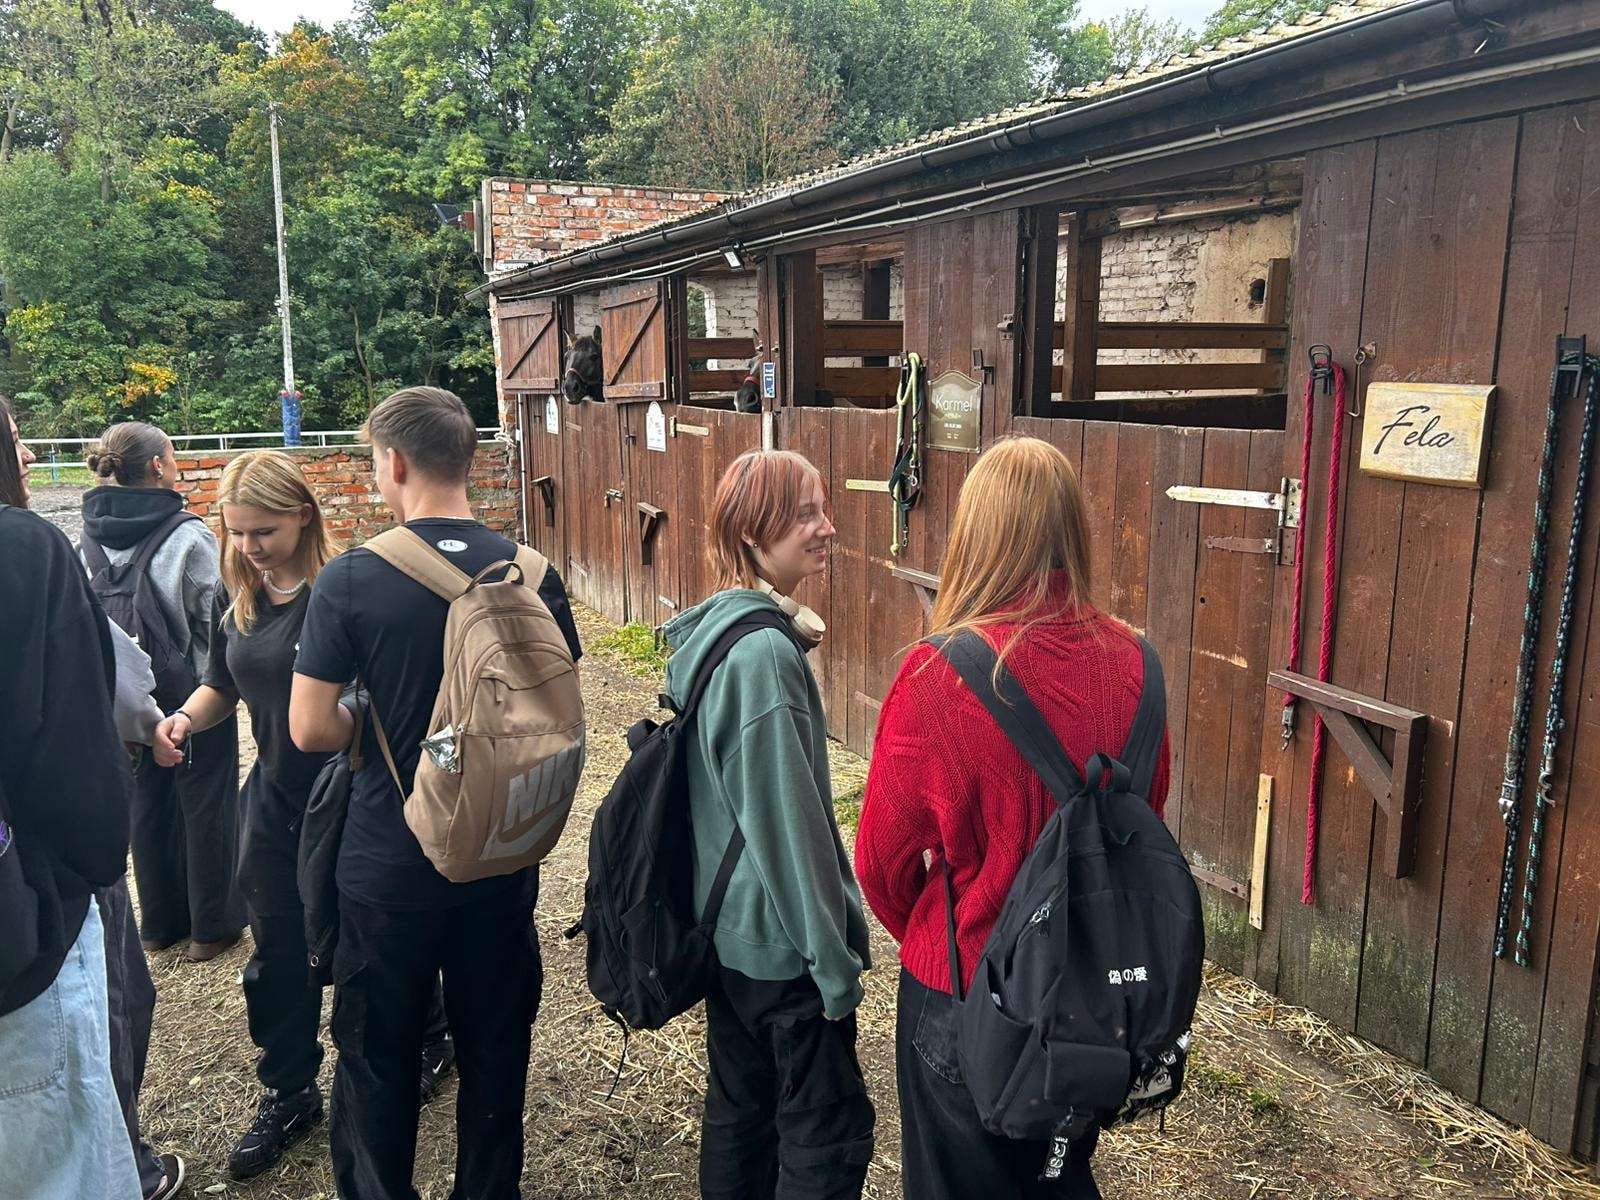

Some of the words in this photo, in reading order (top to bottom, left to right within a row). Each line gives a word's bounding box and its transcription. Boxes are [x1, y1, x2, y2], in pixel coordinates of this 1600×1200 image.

[936, 394, 972, 412] Karmel
[1373, 404, 1456, 456] Fela
[502, 738, 584, 834] NIK
